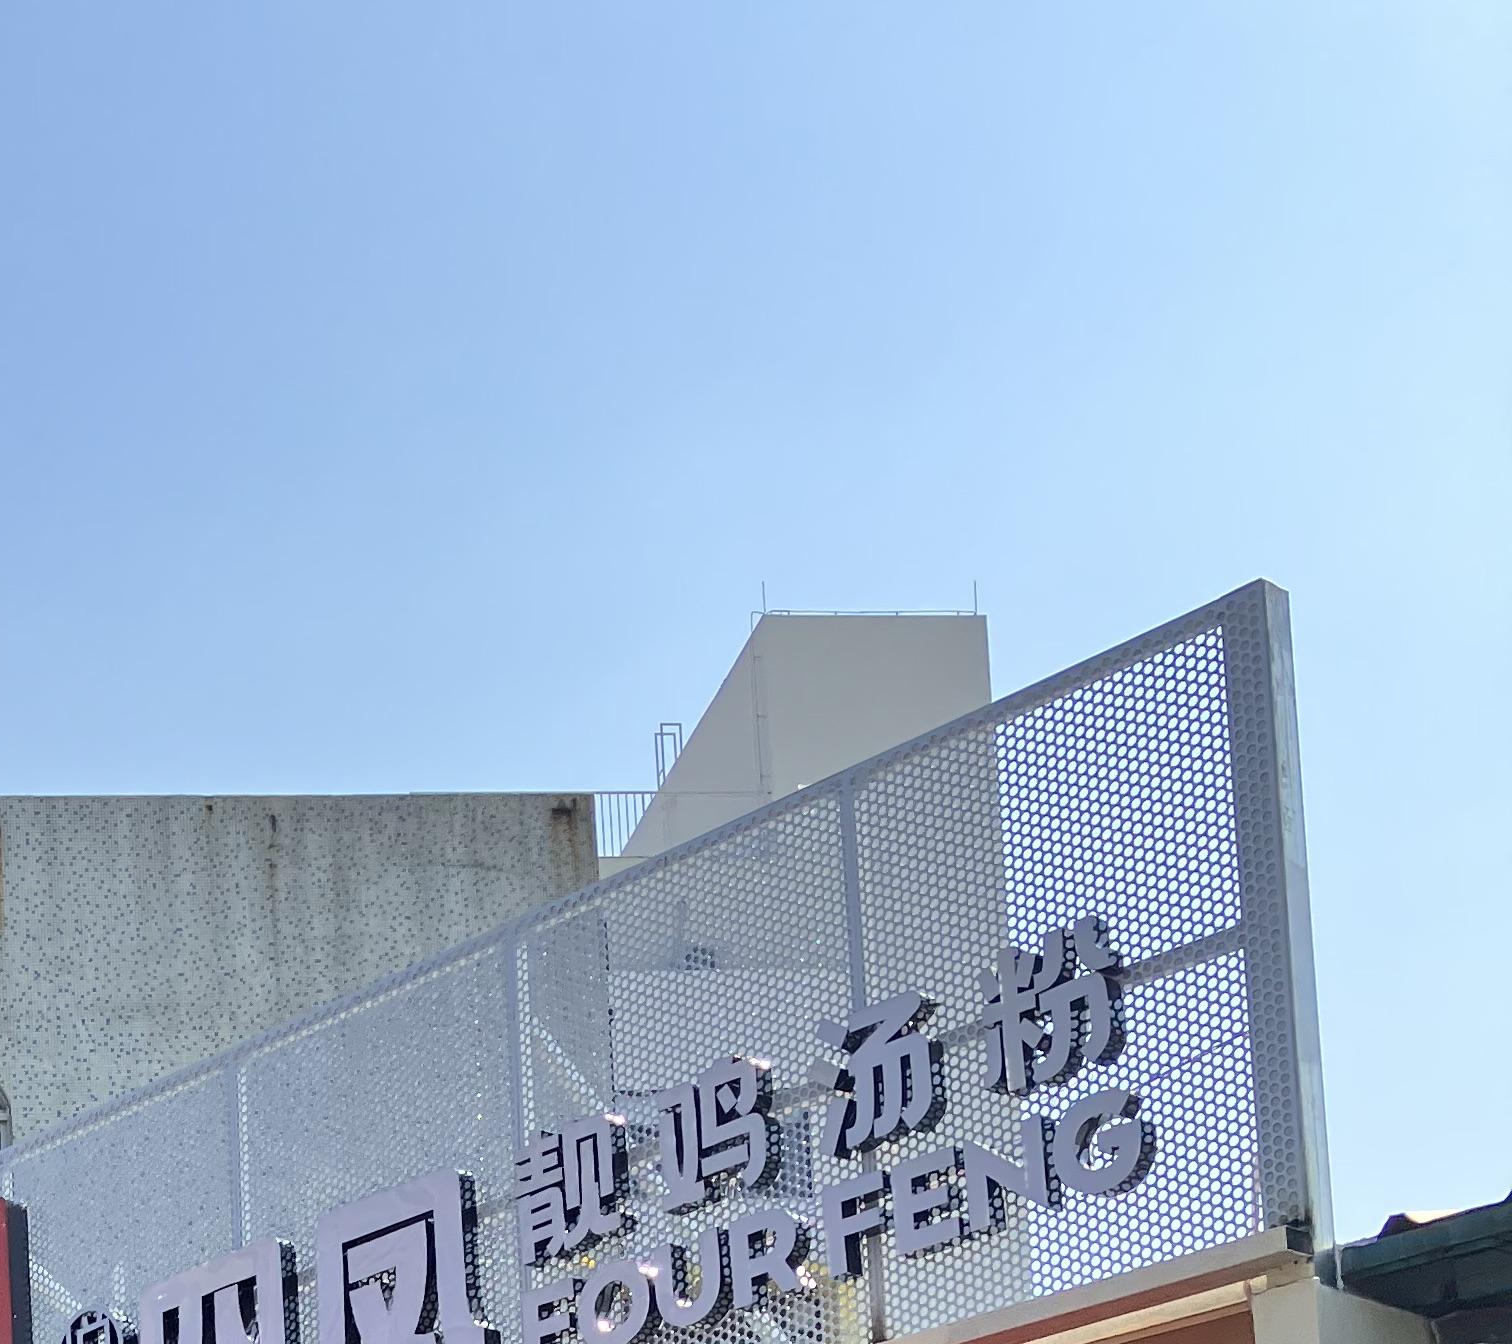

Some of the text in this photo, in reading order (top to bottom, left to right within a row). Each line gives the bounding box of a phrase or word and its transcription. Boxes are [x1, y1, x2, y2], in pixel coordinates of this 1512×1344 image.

[516, 914, 1128, 1264] 靓鸡汤粉
[826, 1088, 1150, 1279] FENG
